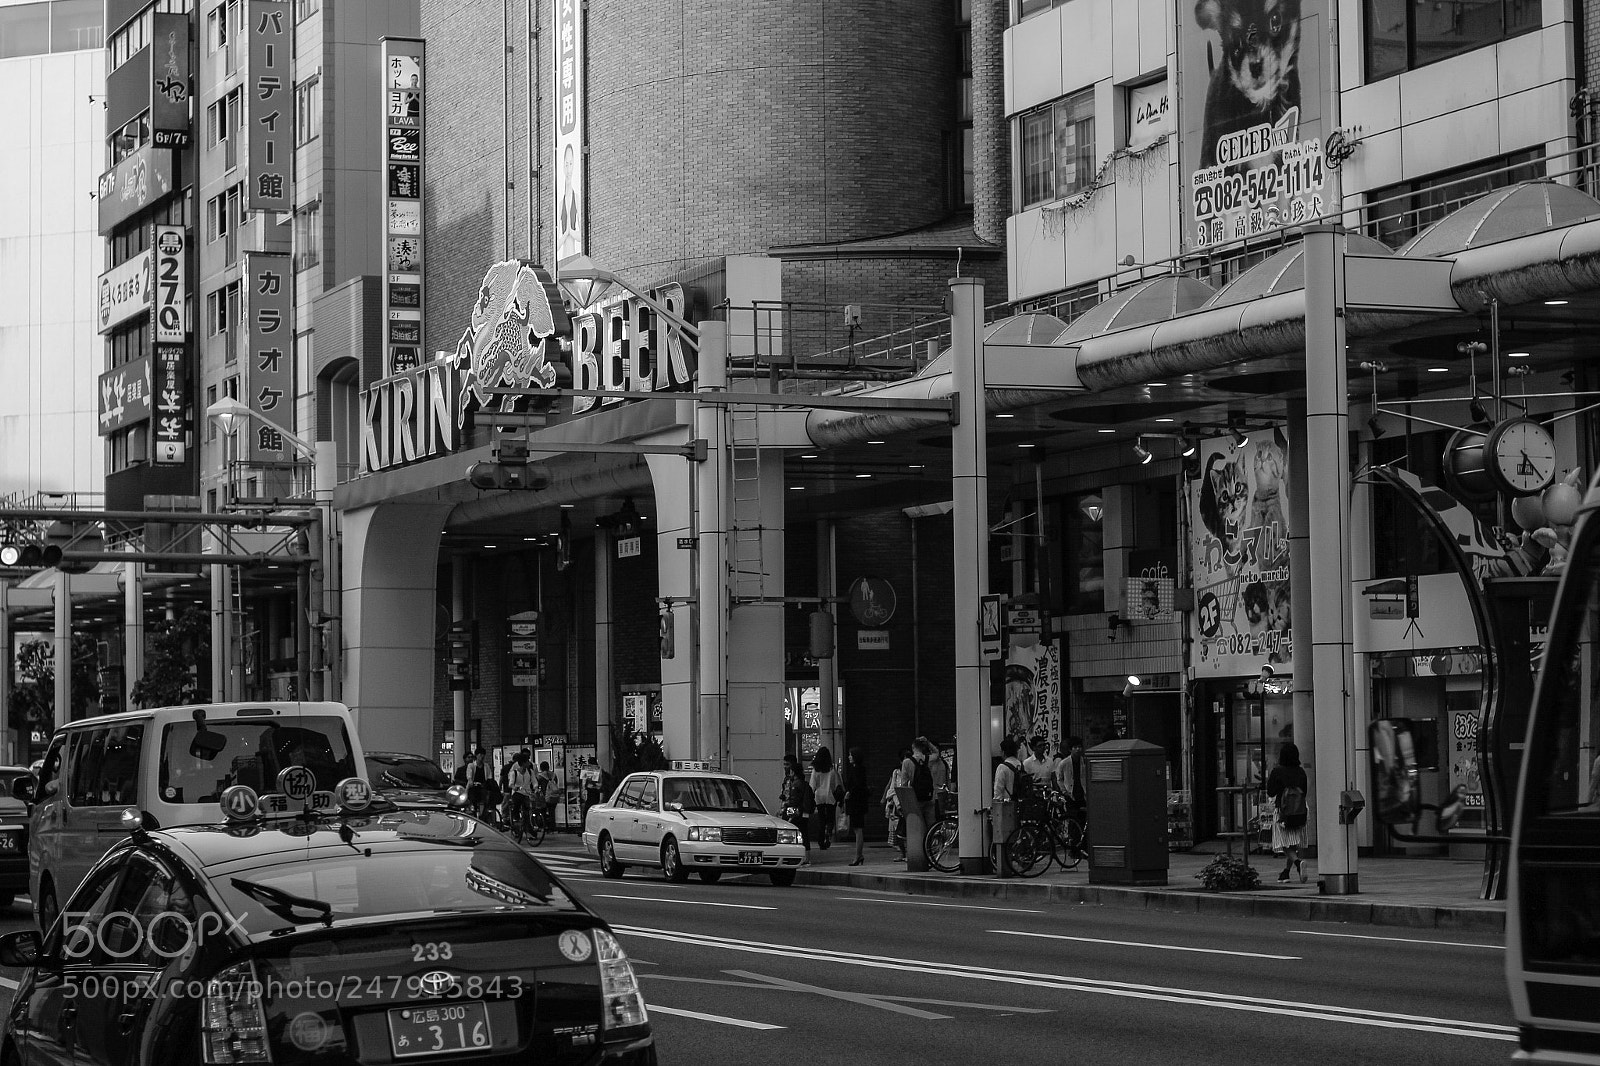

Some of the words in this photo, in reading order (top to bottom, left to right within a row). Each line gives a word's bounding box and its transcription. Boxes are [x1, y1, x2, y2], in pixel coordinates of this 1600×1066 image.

[256, 11, 285, 200] パーティー館
[393, 116, 415, 126] LAVA
[155, 132, 188, 145] 6F/7F
[390, 136, 419, 152] Bee
[1218, 128, 1271, 164] CELEB
[1193, 169, 1224, 185] お問い合わせ
[1214, 156, 1323, 212] 082-542-1114
[159, 232, 182, 254] 黒
[1197, 221, 1224, 246] 3階
[256, 270, 285, 452] カラオケ館
[358, 363, 453, 475] KIRIN
[571, 281, 690, 415] BEER
[1200, 598, 1218, 632] 2F
[231, 791, 255, 813] 小
[411, 942, 453, 962] 233
